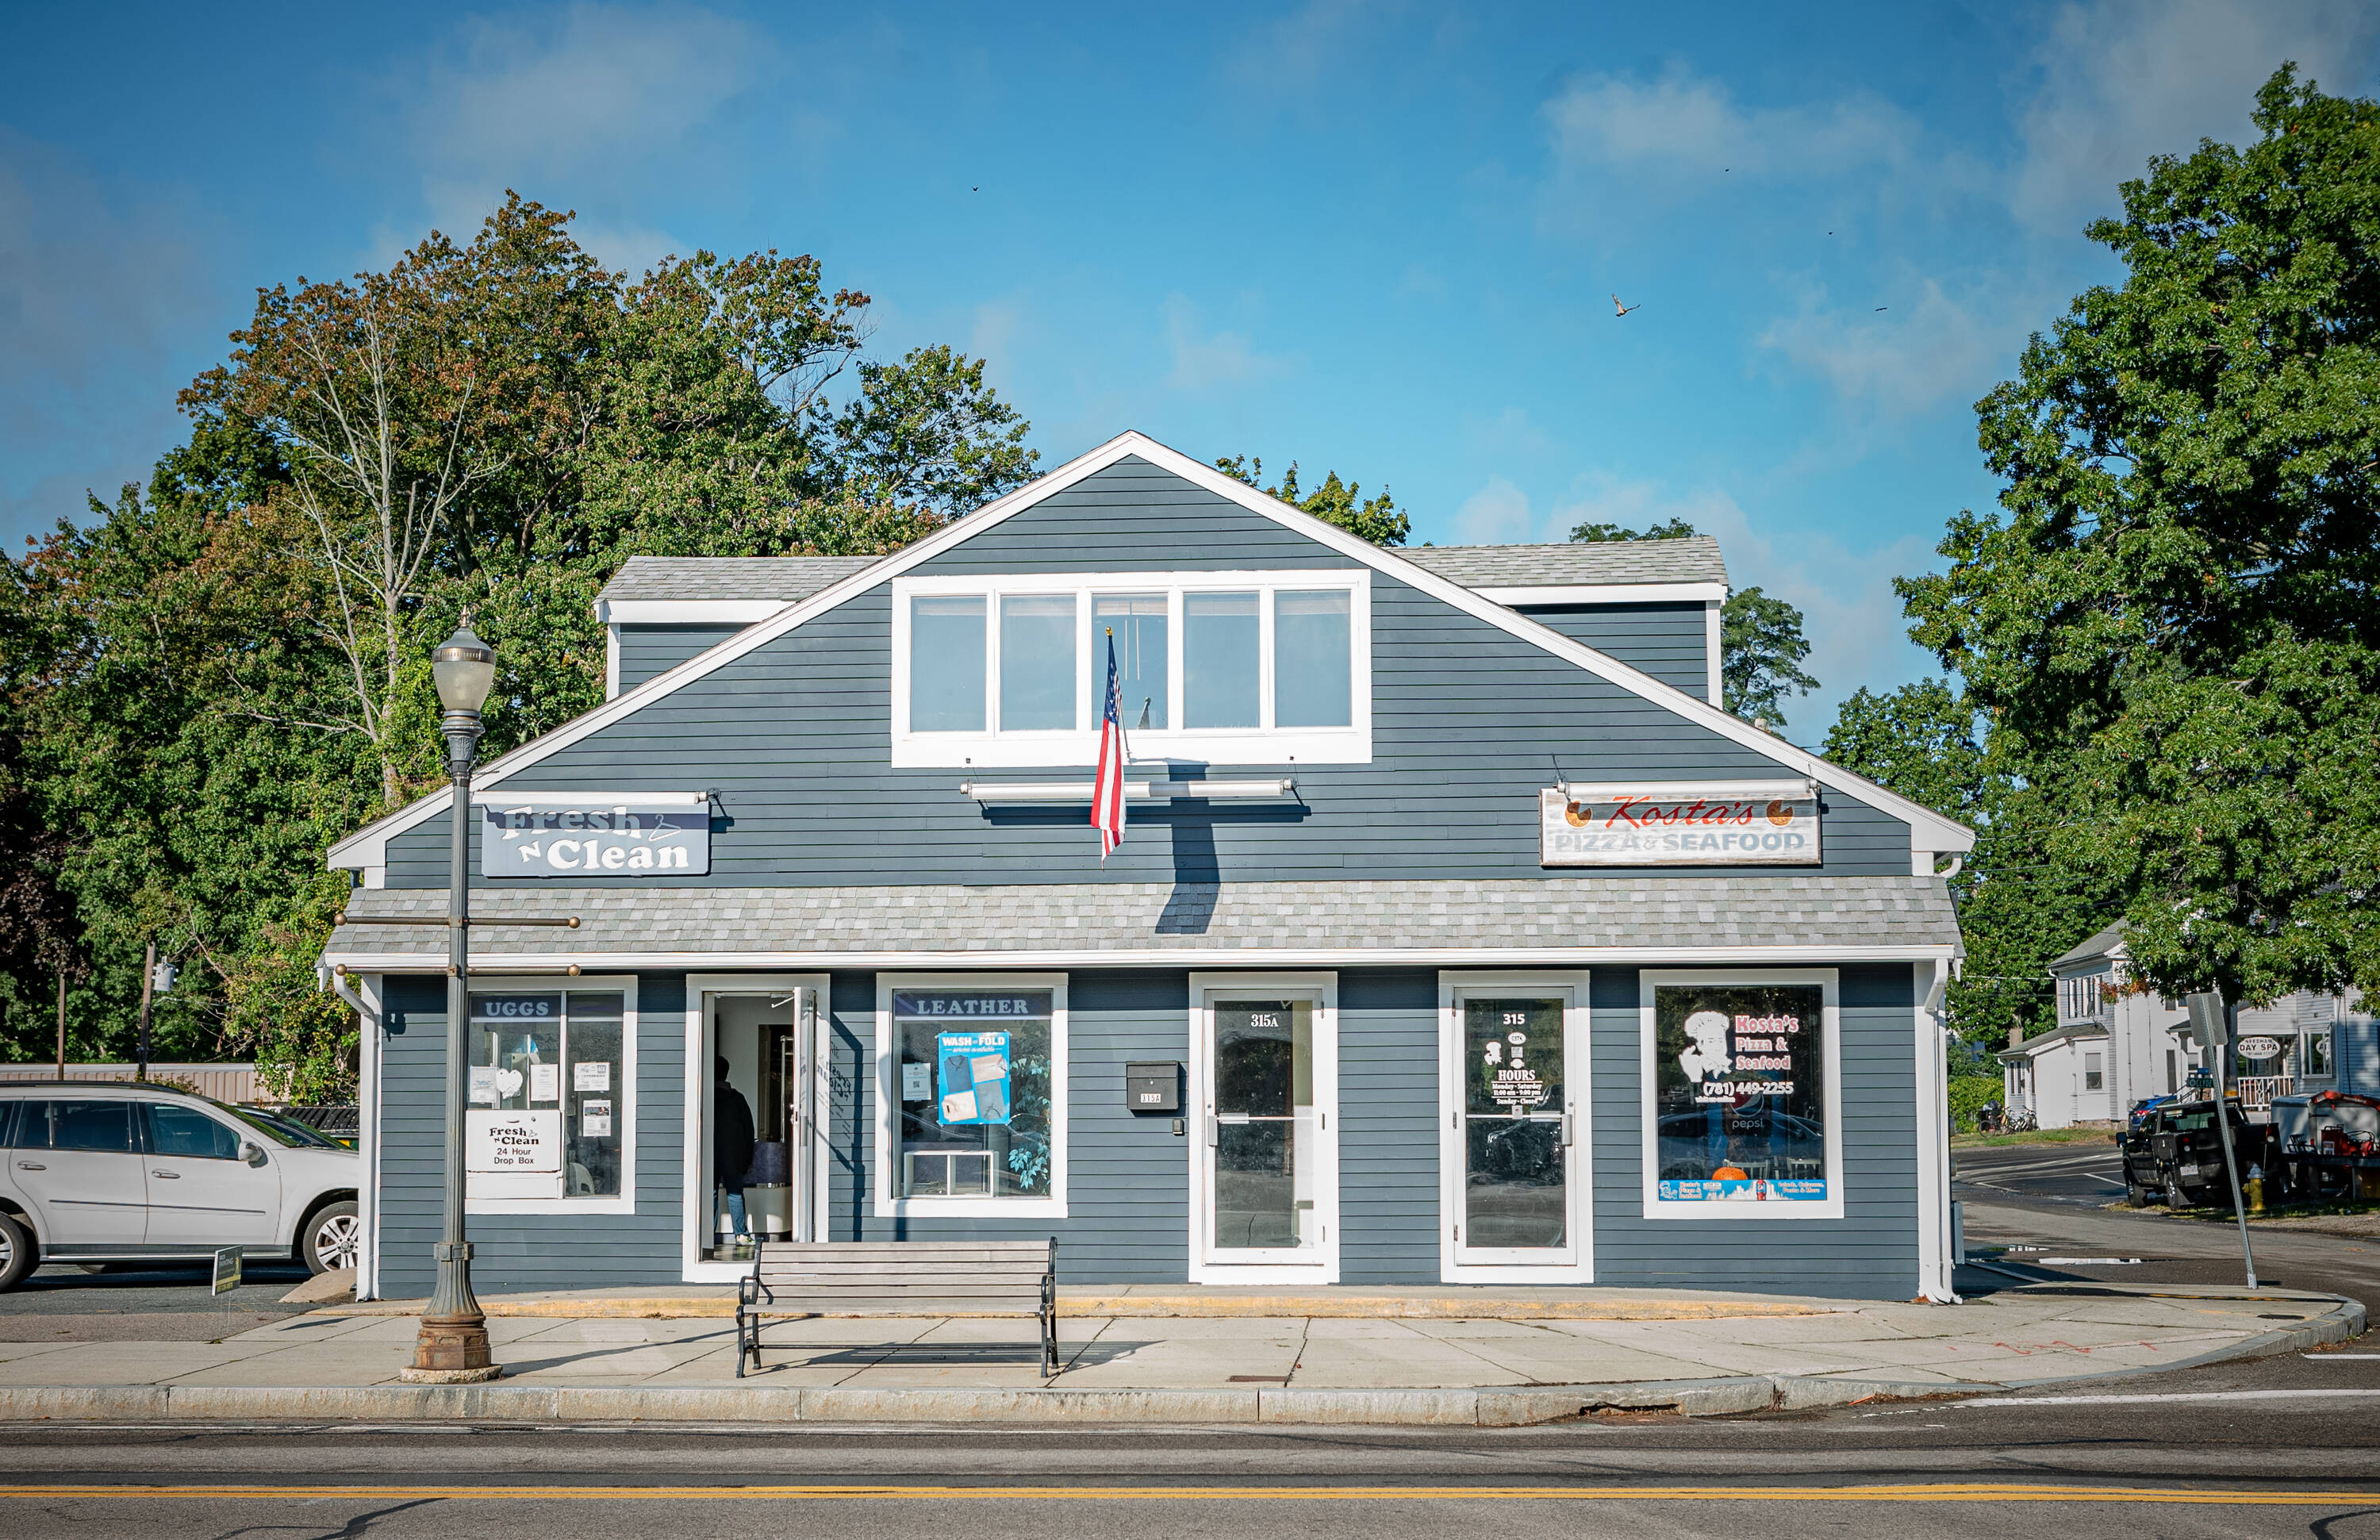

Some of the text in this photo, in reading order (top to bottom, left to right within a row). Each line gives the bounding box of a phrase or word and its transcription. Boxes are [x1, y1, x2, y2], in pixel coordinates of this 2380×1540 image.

[1605, 796, 1754, 828] Kosta's
[501, 806, 641, 839] Fresh
[1555, 832, 1805, 852] PIZZA & SEAFOOD
[547, 839, 689, 869] Clean
[486, 1002, 549, 1016] UGGS
[916, 1000, 1029, 1015] LEATHER
[1250, 1014, 1279, 1027] 315A
[1503, 1013, 1526, 1025] 315
[1735, 1014, 1798, 1033] Kosta's
[942, 1037, 972, 1046] WASH
[978, 1036, 1005, 1046] FOLD
[1735, 1036, 1789, 1052] Pizza &
[1736, 1055, 1791, 1070] Seafood
[1498, 1070, 1536, 1081] HOURS
[1703, 1081, 1794, 1096] (781) 449-2255
[1732, 1118, 1763, 1129] pepsi
[489, 1127, 527, 1136] Fresh
[501, 1136, 539, 1145] Clean
[494, 1157, 514, 1166] Drop
